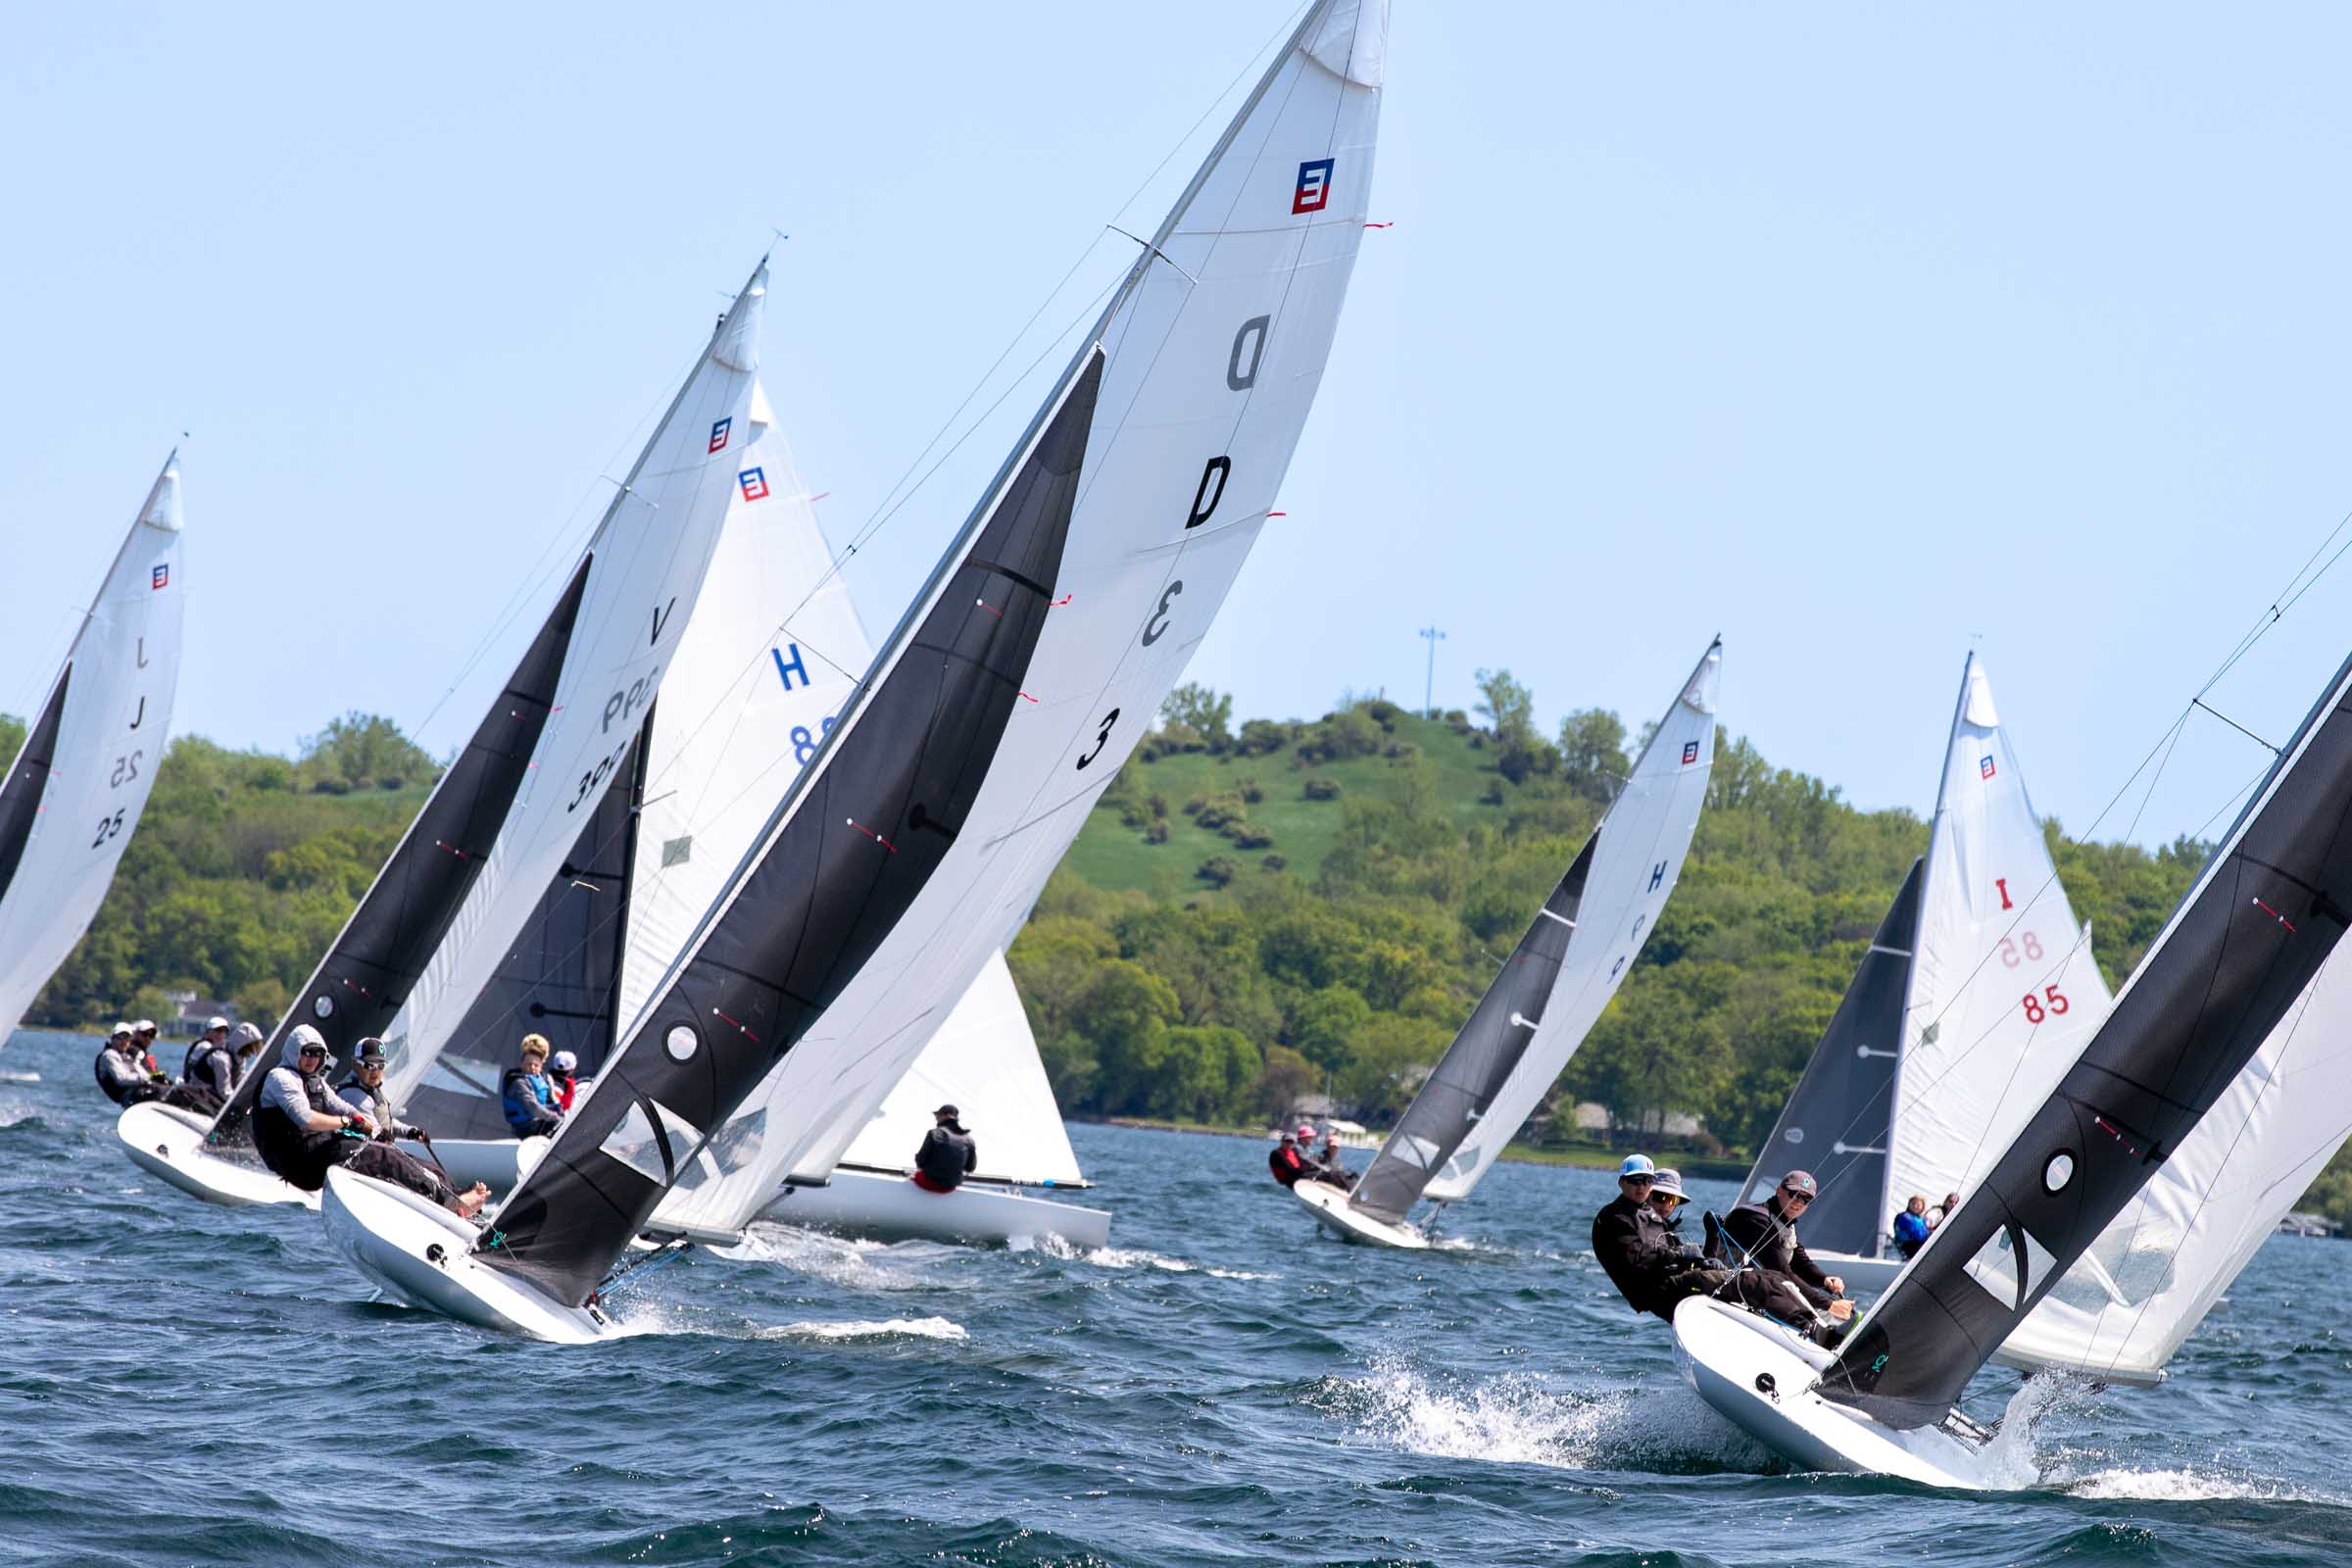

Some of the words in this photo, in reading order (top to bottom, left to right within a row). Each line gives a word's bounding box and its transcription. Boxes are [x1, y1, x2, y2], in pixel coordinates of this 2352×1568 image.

[1185, 456, 1231, 529] D
[651, 597, 676, 647] V
[772, 643, 810, 691] H
[130, 696, 145, 729] J
[1077, 708, 1120, 770] 3
[92, 808, 125, 849] 25
[1647, 860, 1668, 894] H
[1995, 878, 2014, 909] I
[2023, 984, 2070, 1024] 85
